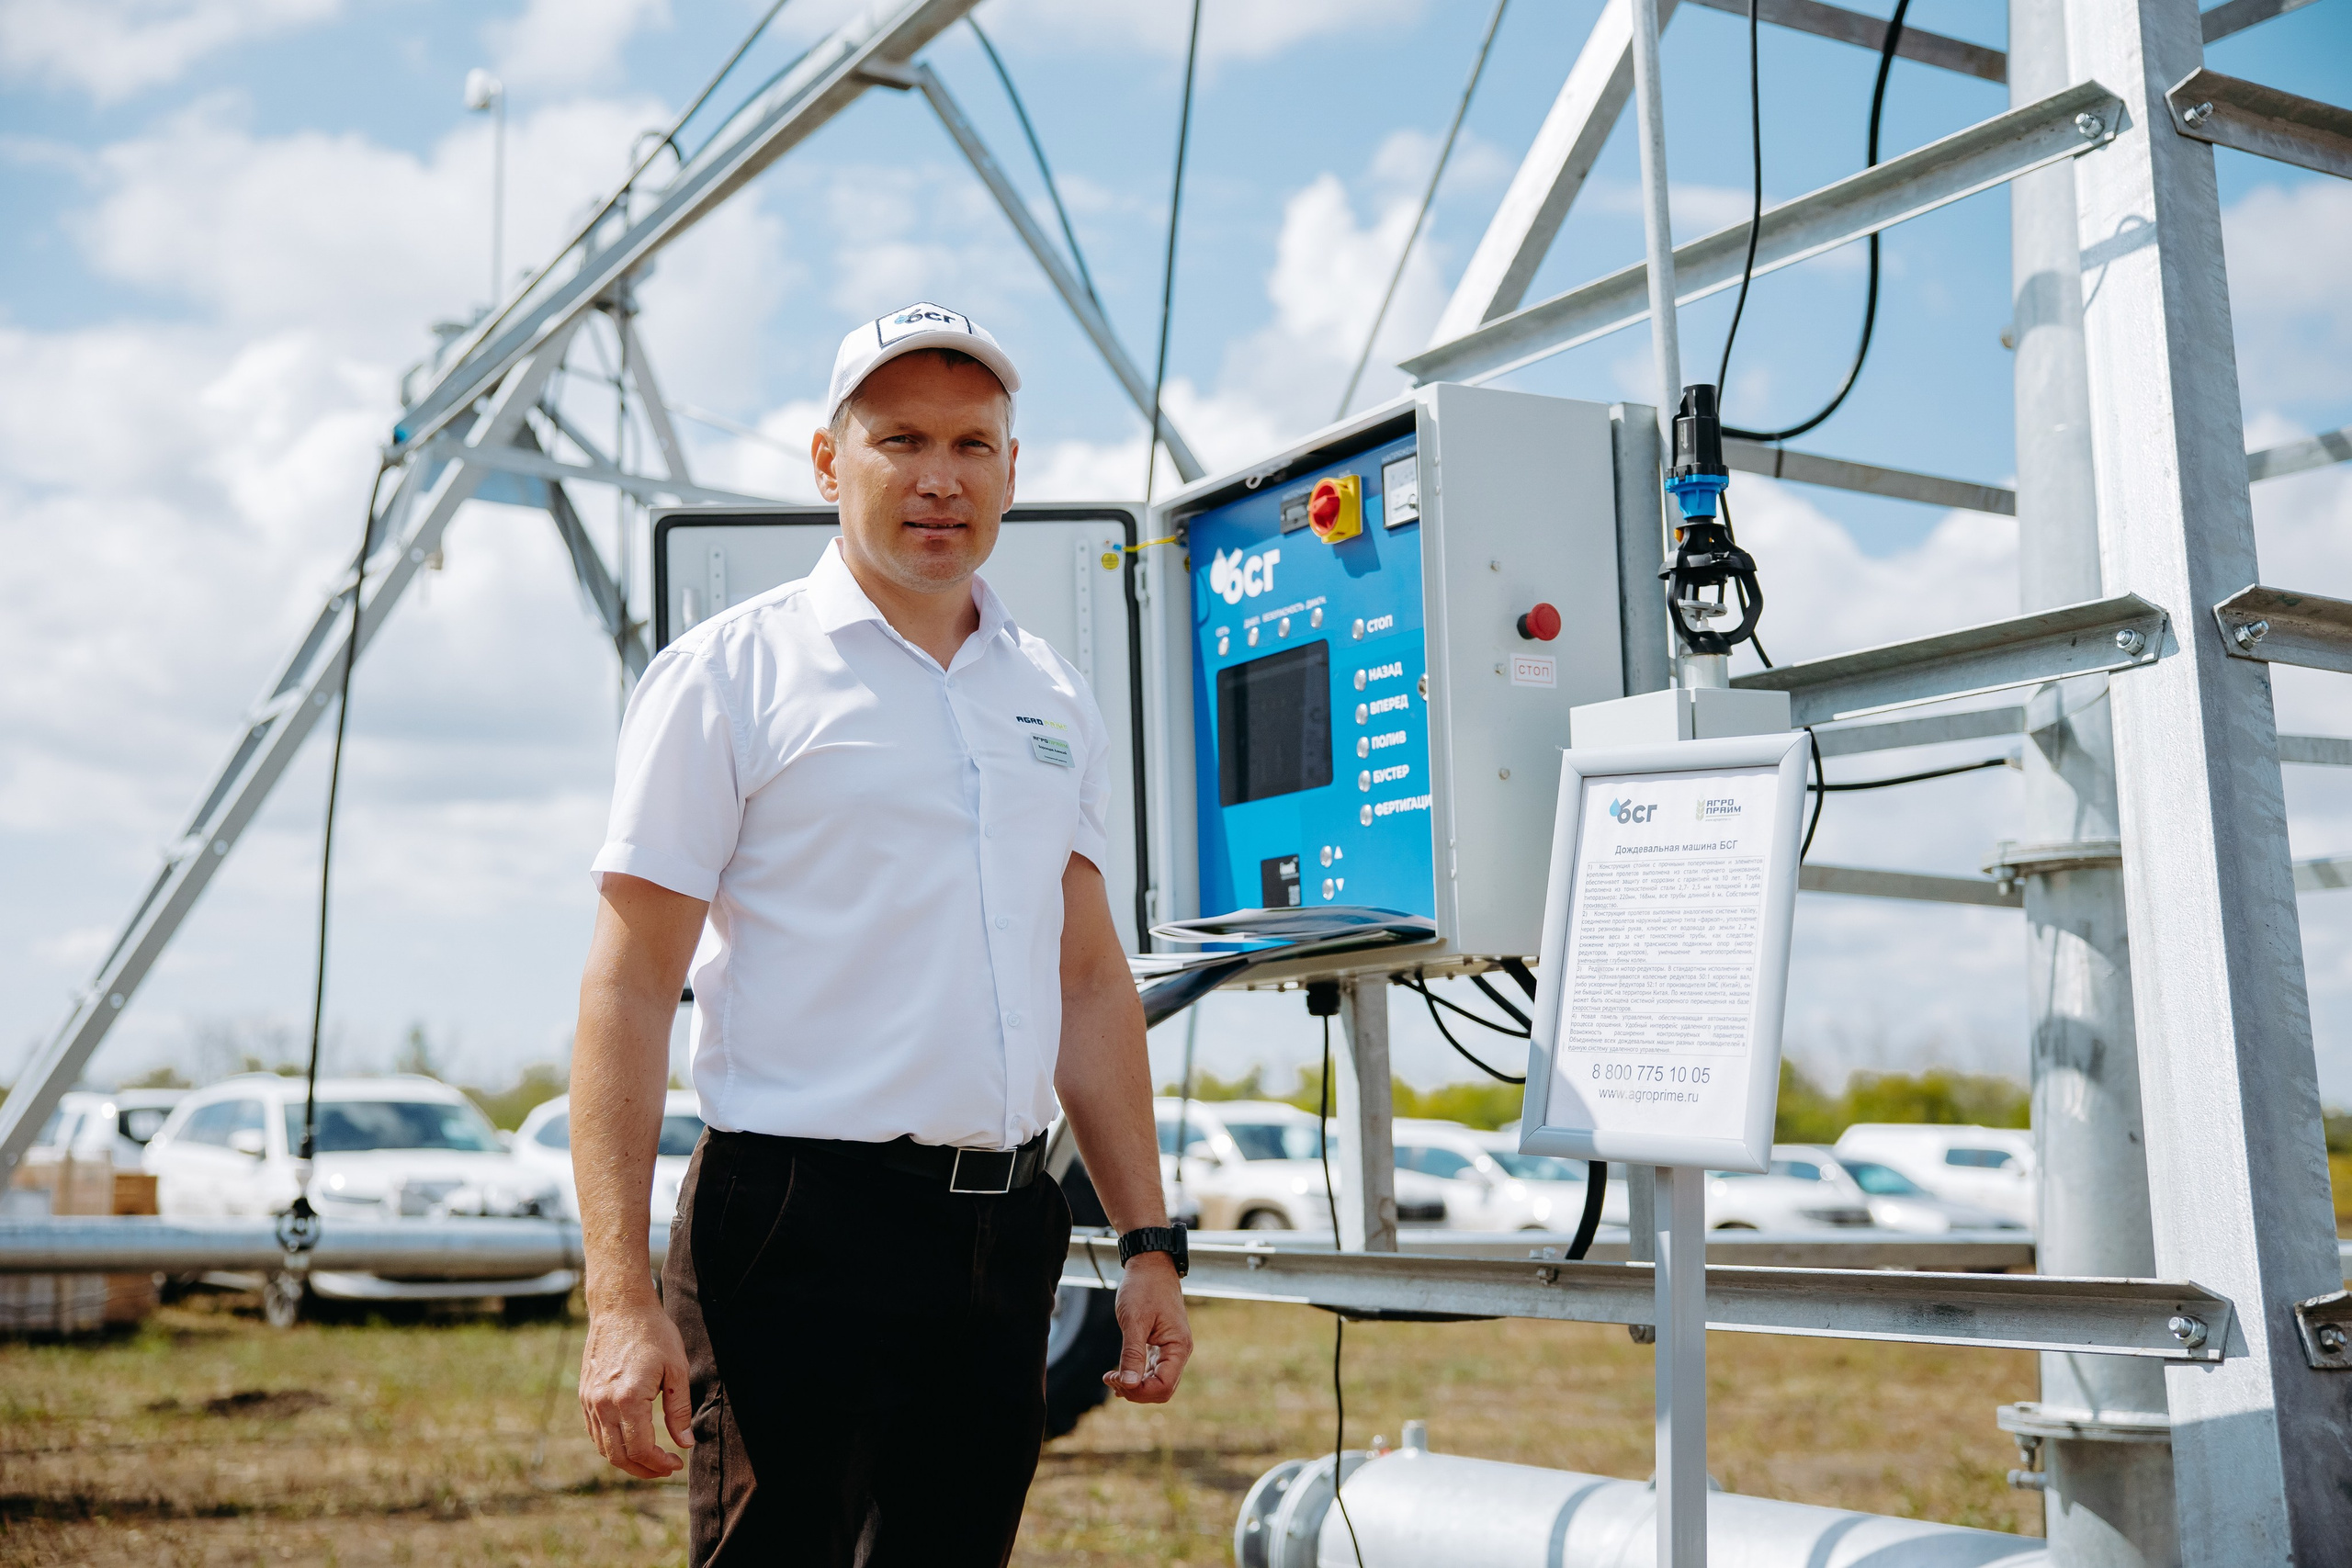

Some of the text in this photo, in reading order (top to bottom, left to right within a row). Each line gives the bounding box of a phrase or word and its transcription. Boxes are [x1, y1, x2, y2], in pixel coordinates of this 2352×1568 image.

[1366, 615, 1393, 633] СТОП
[1367, 661, 1403, 682] НАЗАД
[1518, 664, 1550, 677] СТОП
[1370, 694, 1409, 715] ВПЕРЕД
[1371, 729, 1407, 750] ПОЛИВ
[1373, 764, 1410, 784] БУСТЕР
[1706, 798, 1734, 807] АГРО
[1614, 840, 1738, 856] Дождевальная машина БСГ
[1592, 1064, 1711, 1084] 8 800 775 10 05
[1599, 1088, 1699, 1103] www.agroprime.ru
